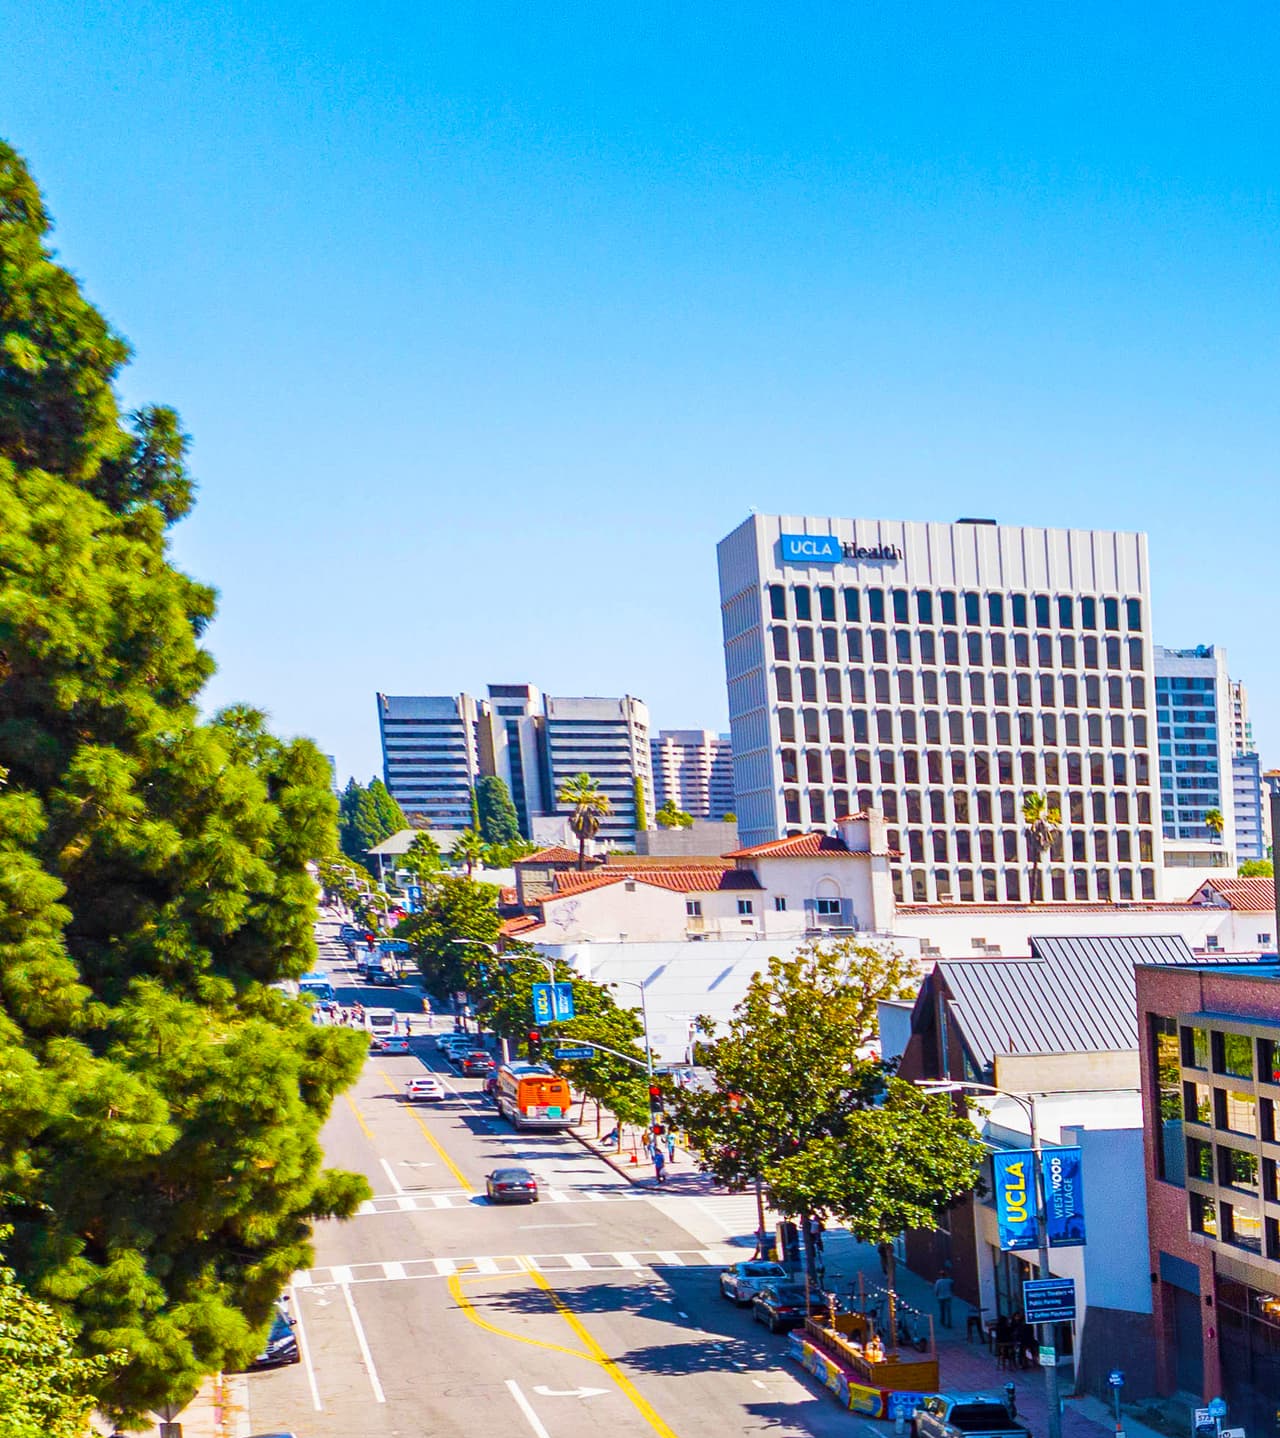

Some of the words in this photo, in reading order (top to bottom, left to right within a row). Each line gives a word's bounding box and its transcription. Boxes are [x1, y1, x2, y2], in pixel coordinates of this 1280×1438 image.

[790, 541, 832, 555] UCLA
[841, 542, 903, 560] Health
[1005, 1161, 1028, 1223] UCLA
[1051, 1157, 1064, 1219] WESTWOOD
[1063, 1177, 1075, 1219] VILLAGE
